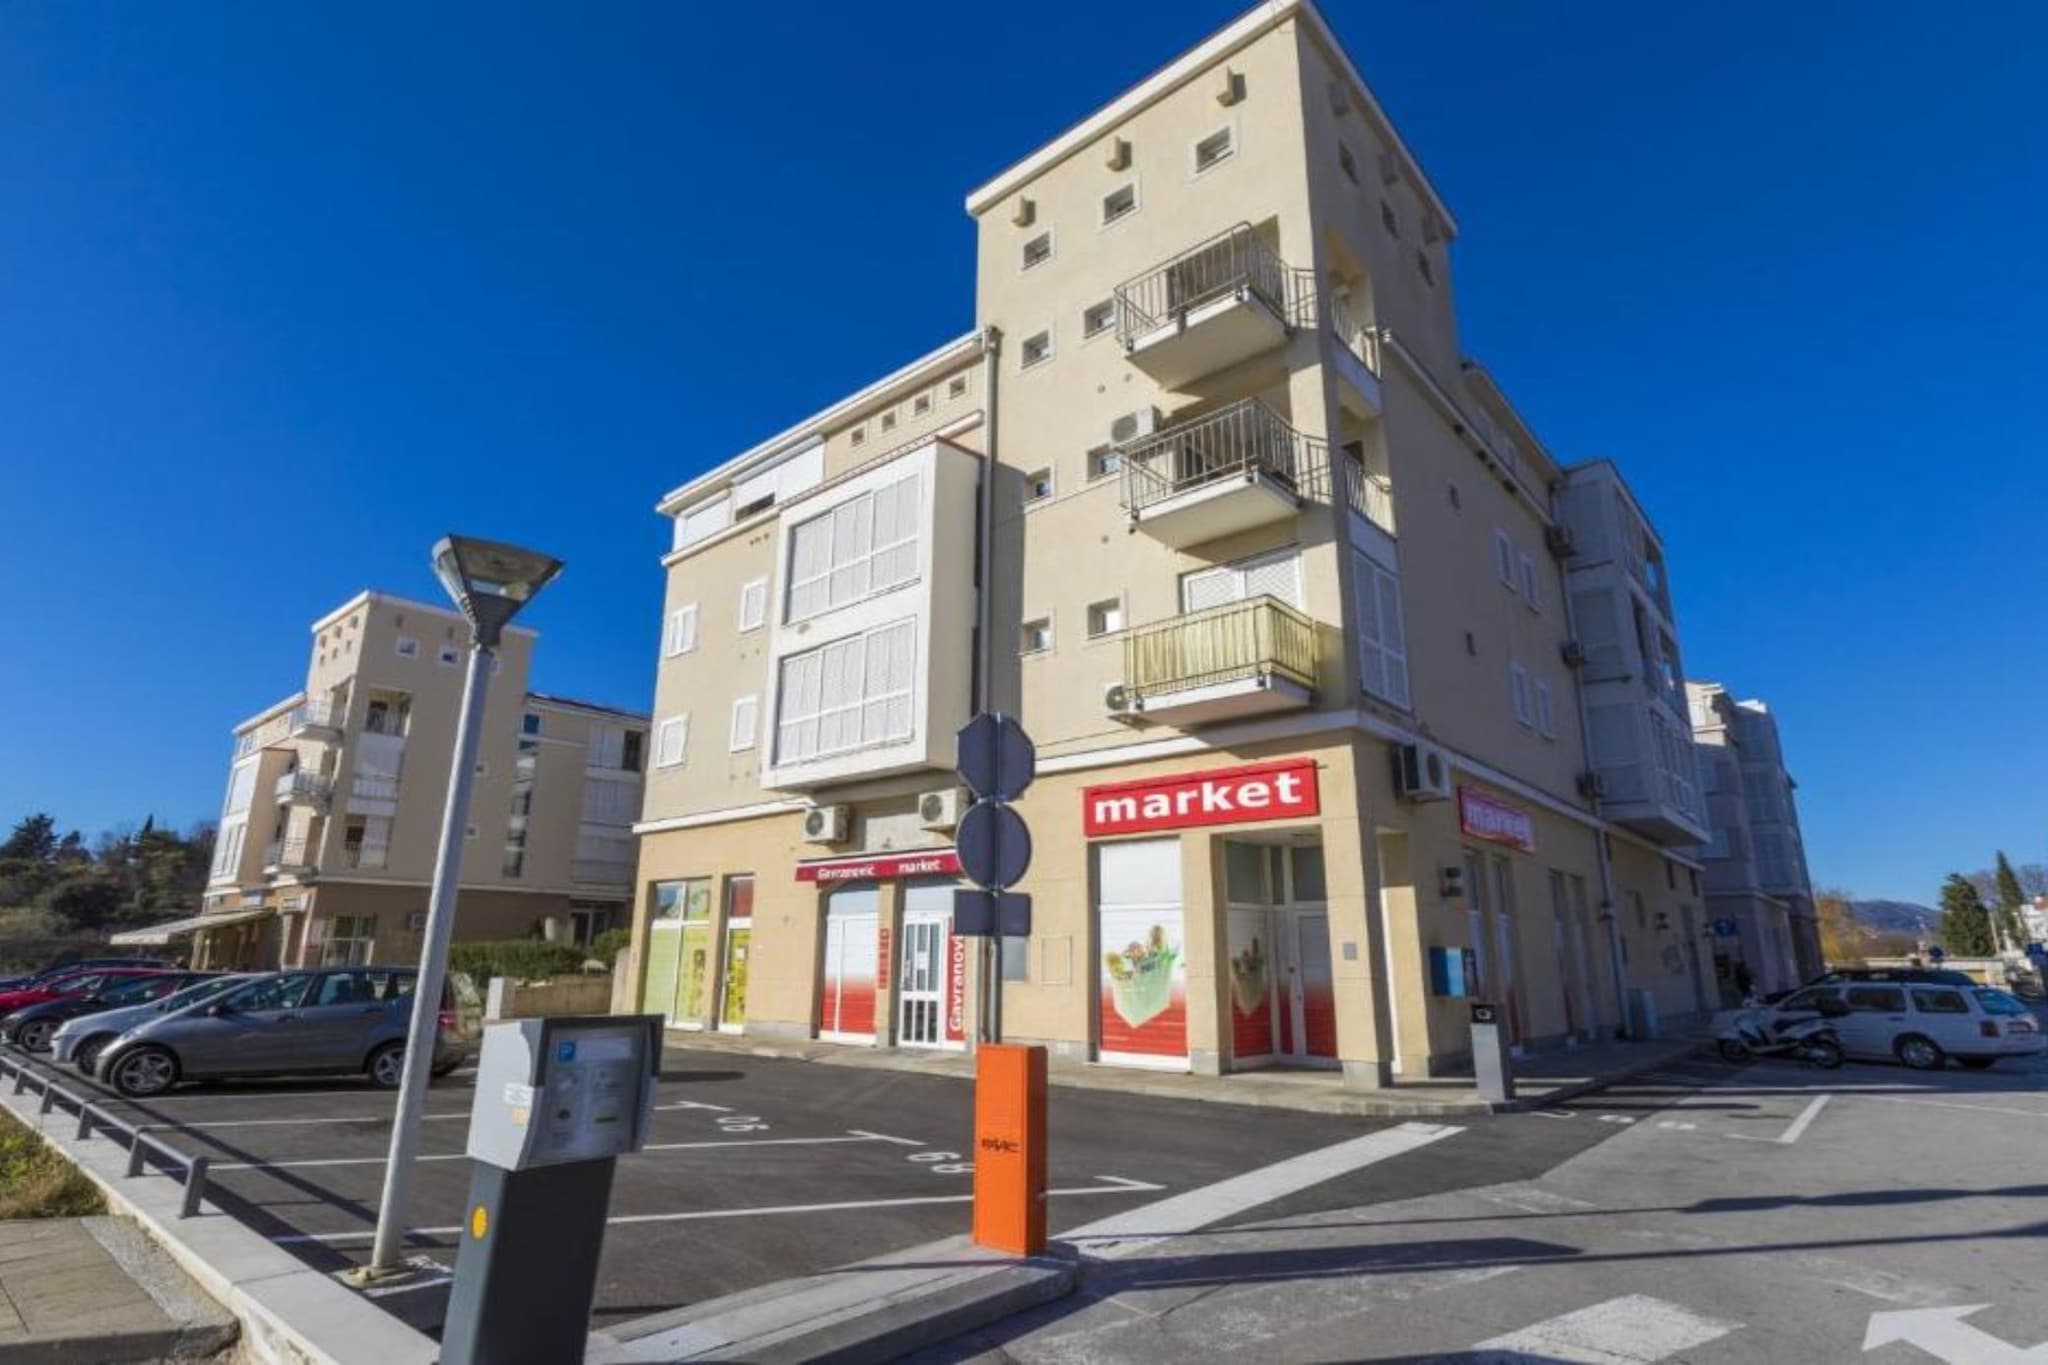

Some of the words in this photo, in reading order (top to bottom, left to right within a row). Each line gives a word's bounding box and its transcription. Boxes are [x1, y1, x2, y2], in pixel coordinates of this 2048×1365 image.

[1095, 772, 1303, 825] market
[897, 858, 942, 874] market
[948, 934, 965, 1032] Gavranovi
